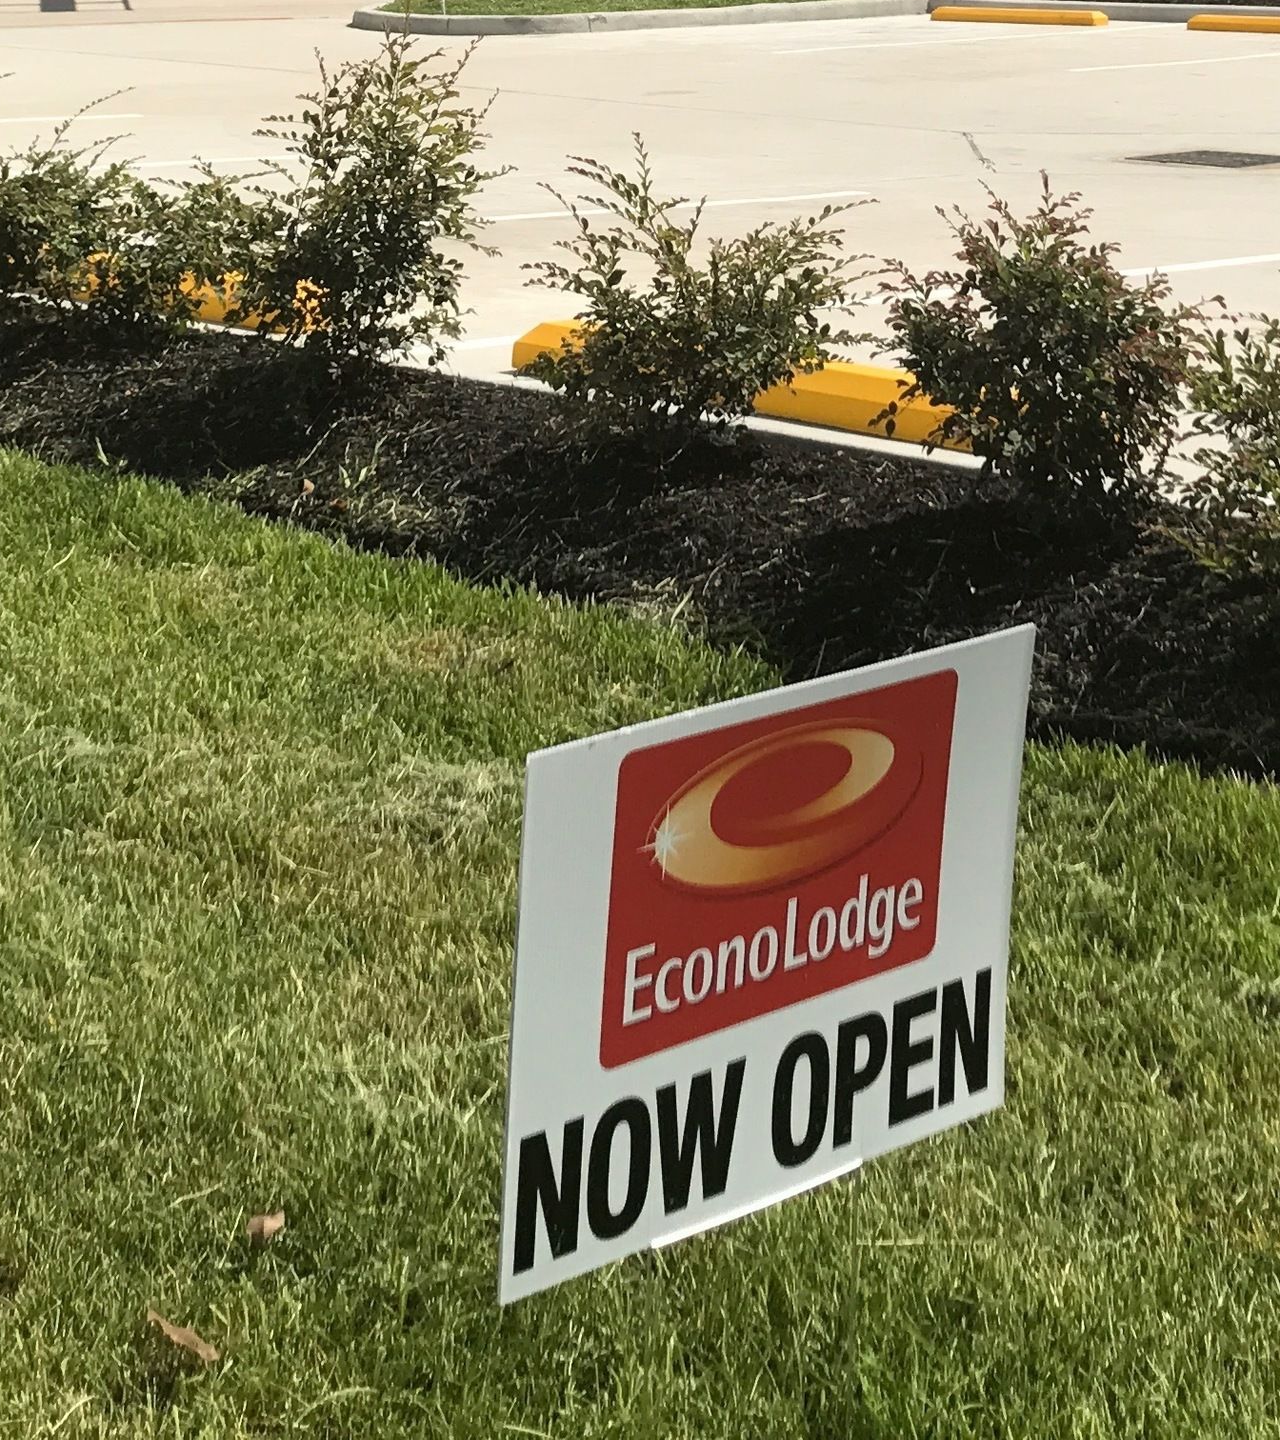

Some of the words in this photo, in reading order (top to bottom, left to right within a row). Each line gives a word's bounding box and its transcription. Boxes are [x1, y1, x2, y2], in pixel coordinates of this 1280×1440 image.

[622, 874, 924, 1027] EconoLodge
[513, 1056, 747, 1276] NOW
[771, 965, 993, 1170] OPEN
